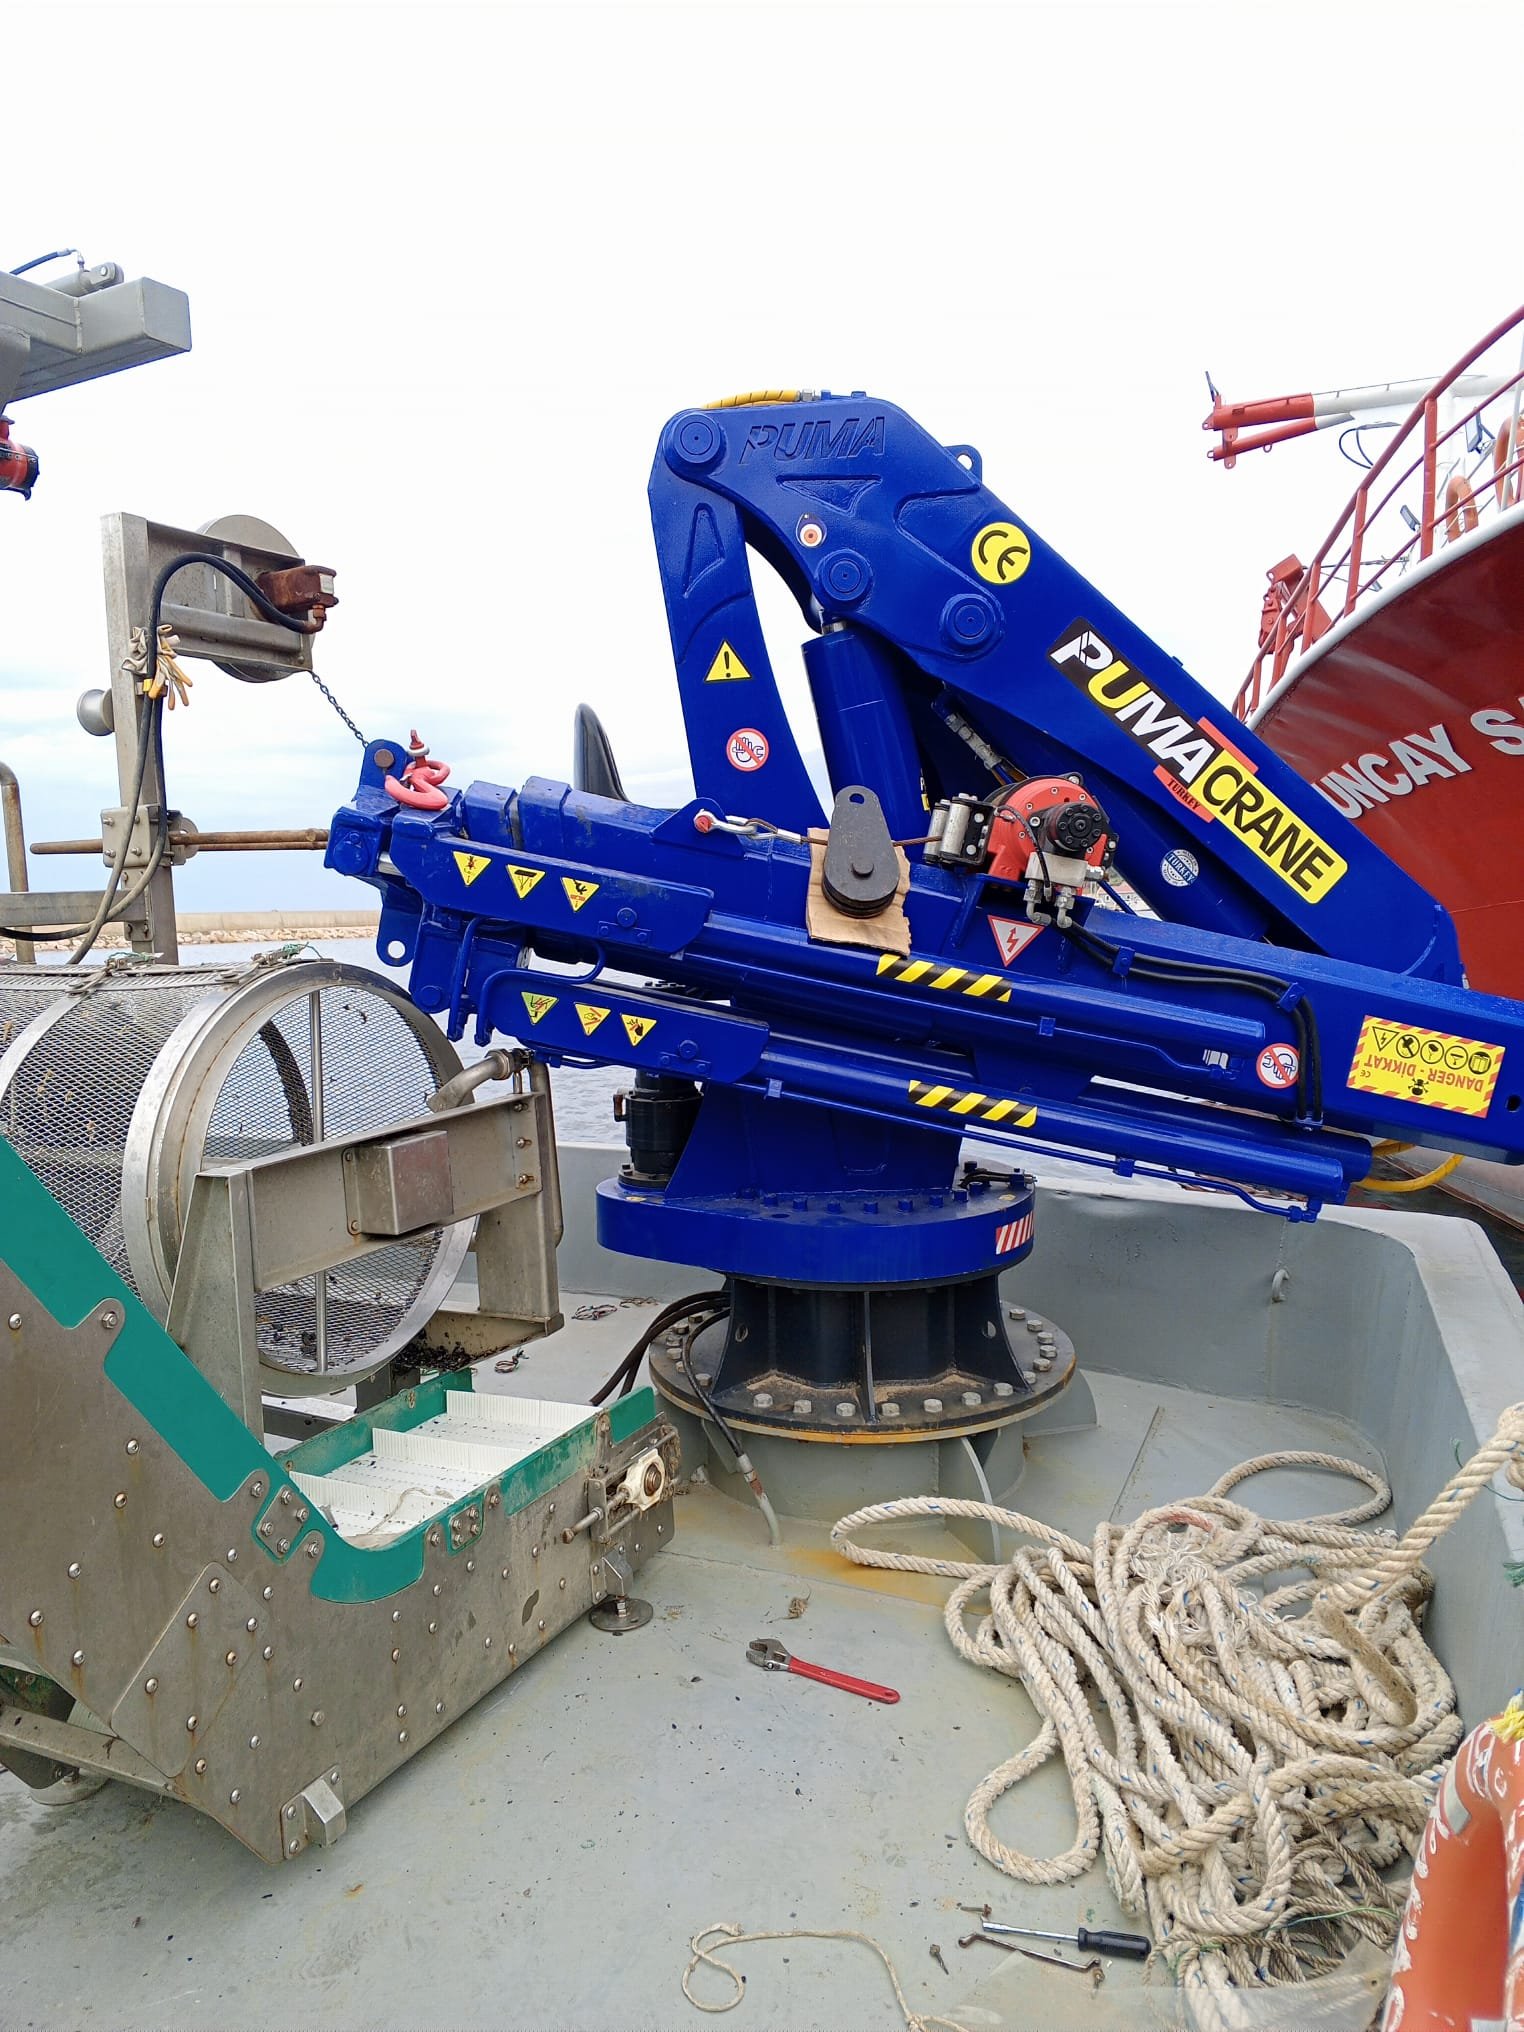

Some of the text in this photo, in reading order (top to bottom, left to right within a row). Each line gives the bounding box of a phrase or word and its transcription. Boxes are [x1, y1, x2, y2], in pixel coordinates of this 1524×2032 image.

[738, 416, 886, 465] PUMA
[1470, 696, 1524, 755] S
[1050, 630, 1335, 892] PUMA CRANE
[1167, 778, 1201, 810] TURKEY
[1167, 853, 1196, 882] TURKEY
[1428, 1068, 1484, 1093] DANGER
